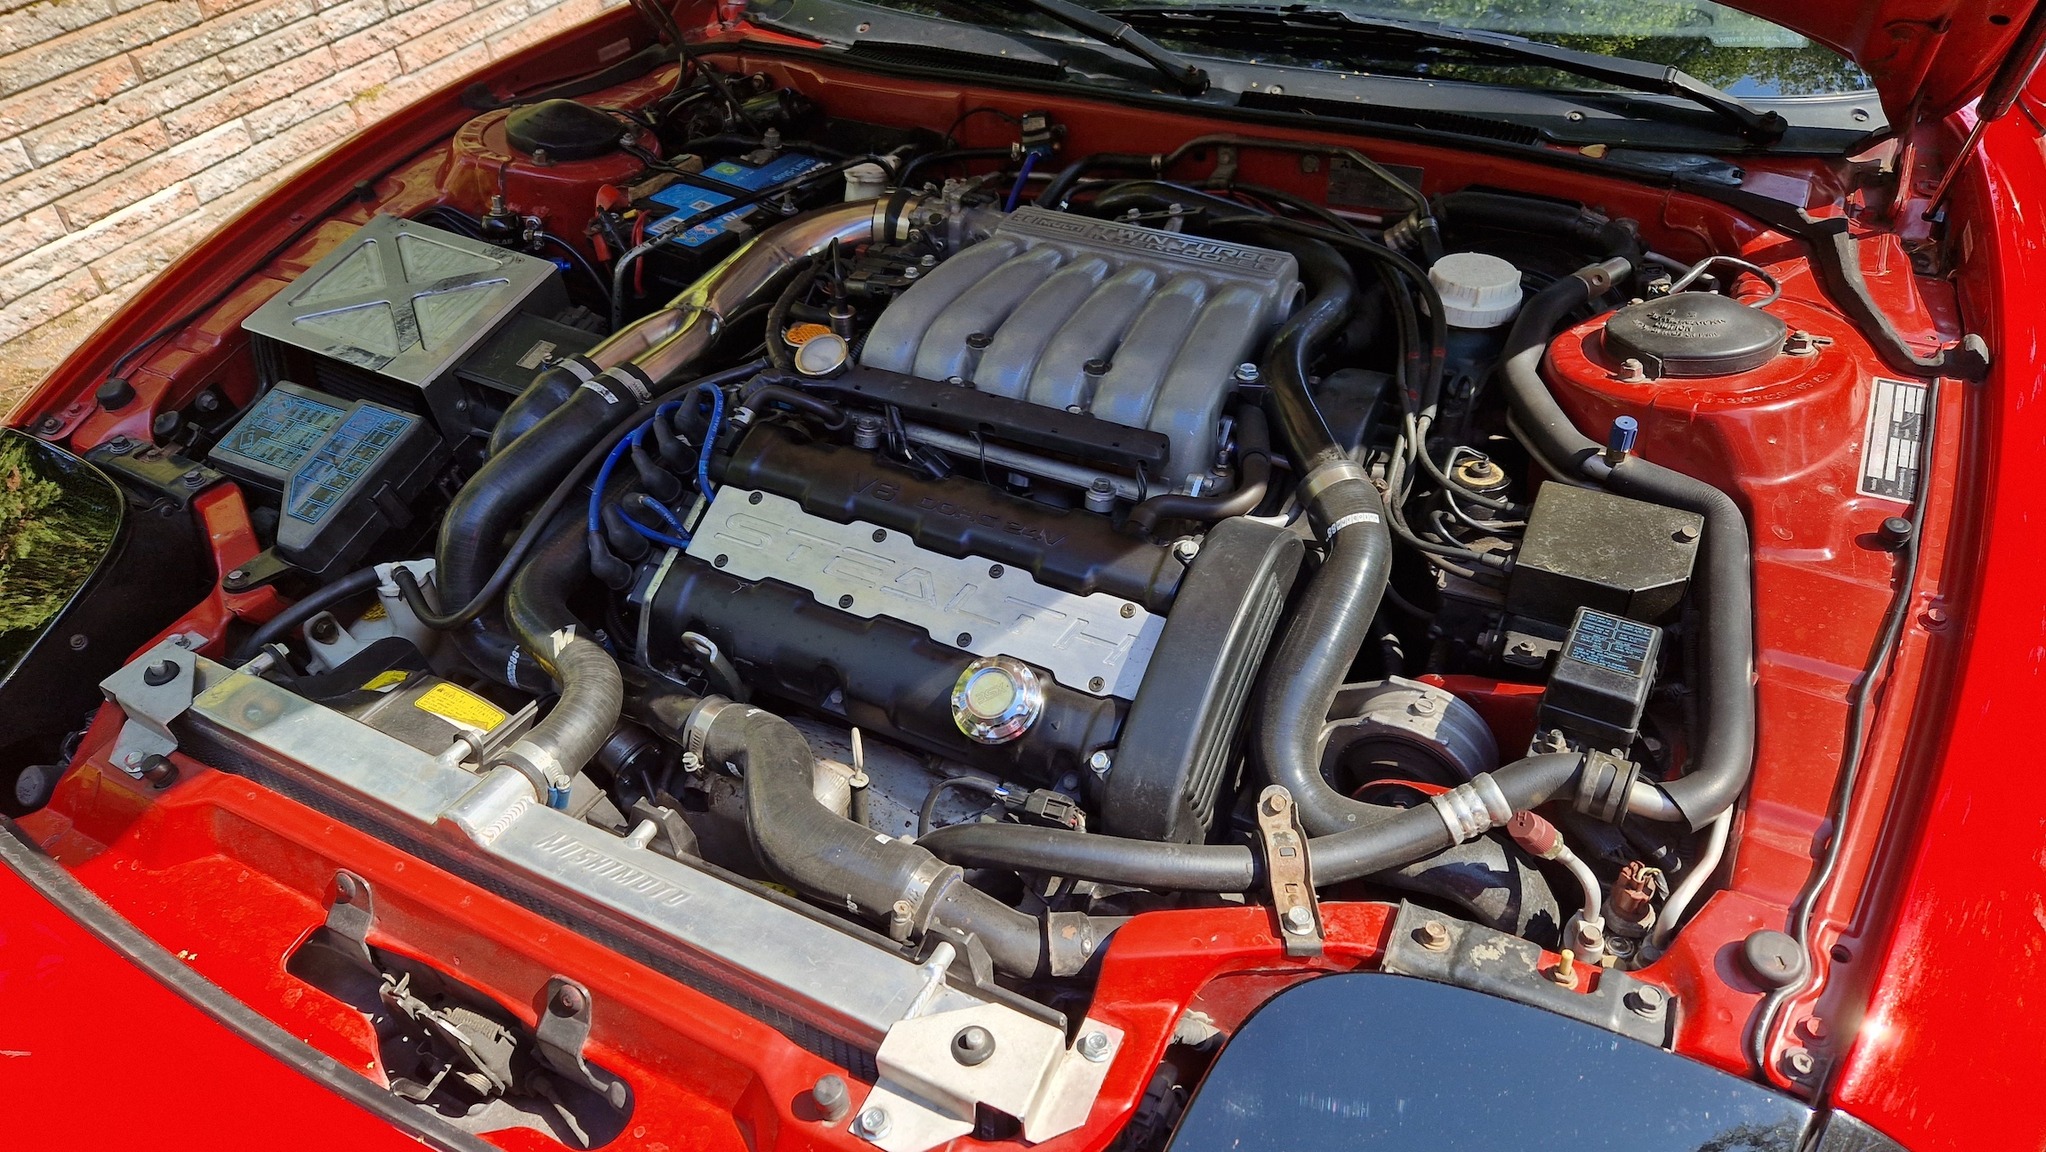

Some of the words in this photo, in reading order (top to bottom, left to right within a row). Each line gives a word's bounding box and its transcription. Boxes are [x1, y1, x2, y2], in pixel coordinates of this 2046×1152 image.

[1039, 216, 1085, 234] MULTI
[1099, 225, 1169, 245] TWIN
[1176, 238, 1284, 266] TURBO
[851, 471, 899, 501] V6
[915, 496, 1002, 529] DOHC
[1002, 520, 1070, 546] 24V
[713, 511, 1140, 667] STEALTH
[534, 830, 694, 907] MISHIMOTO
